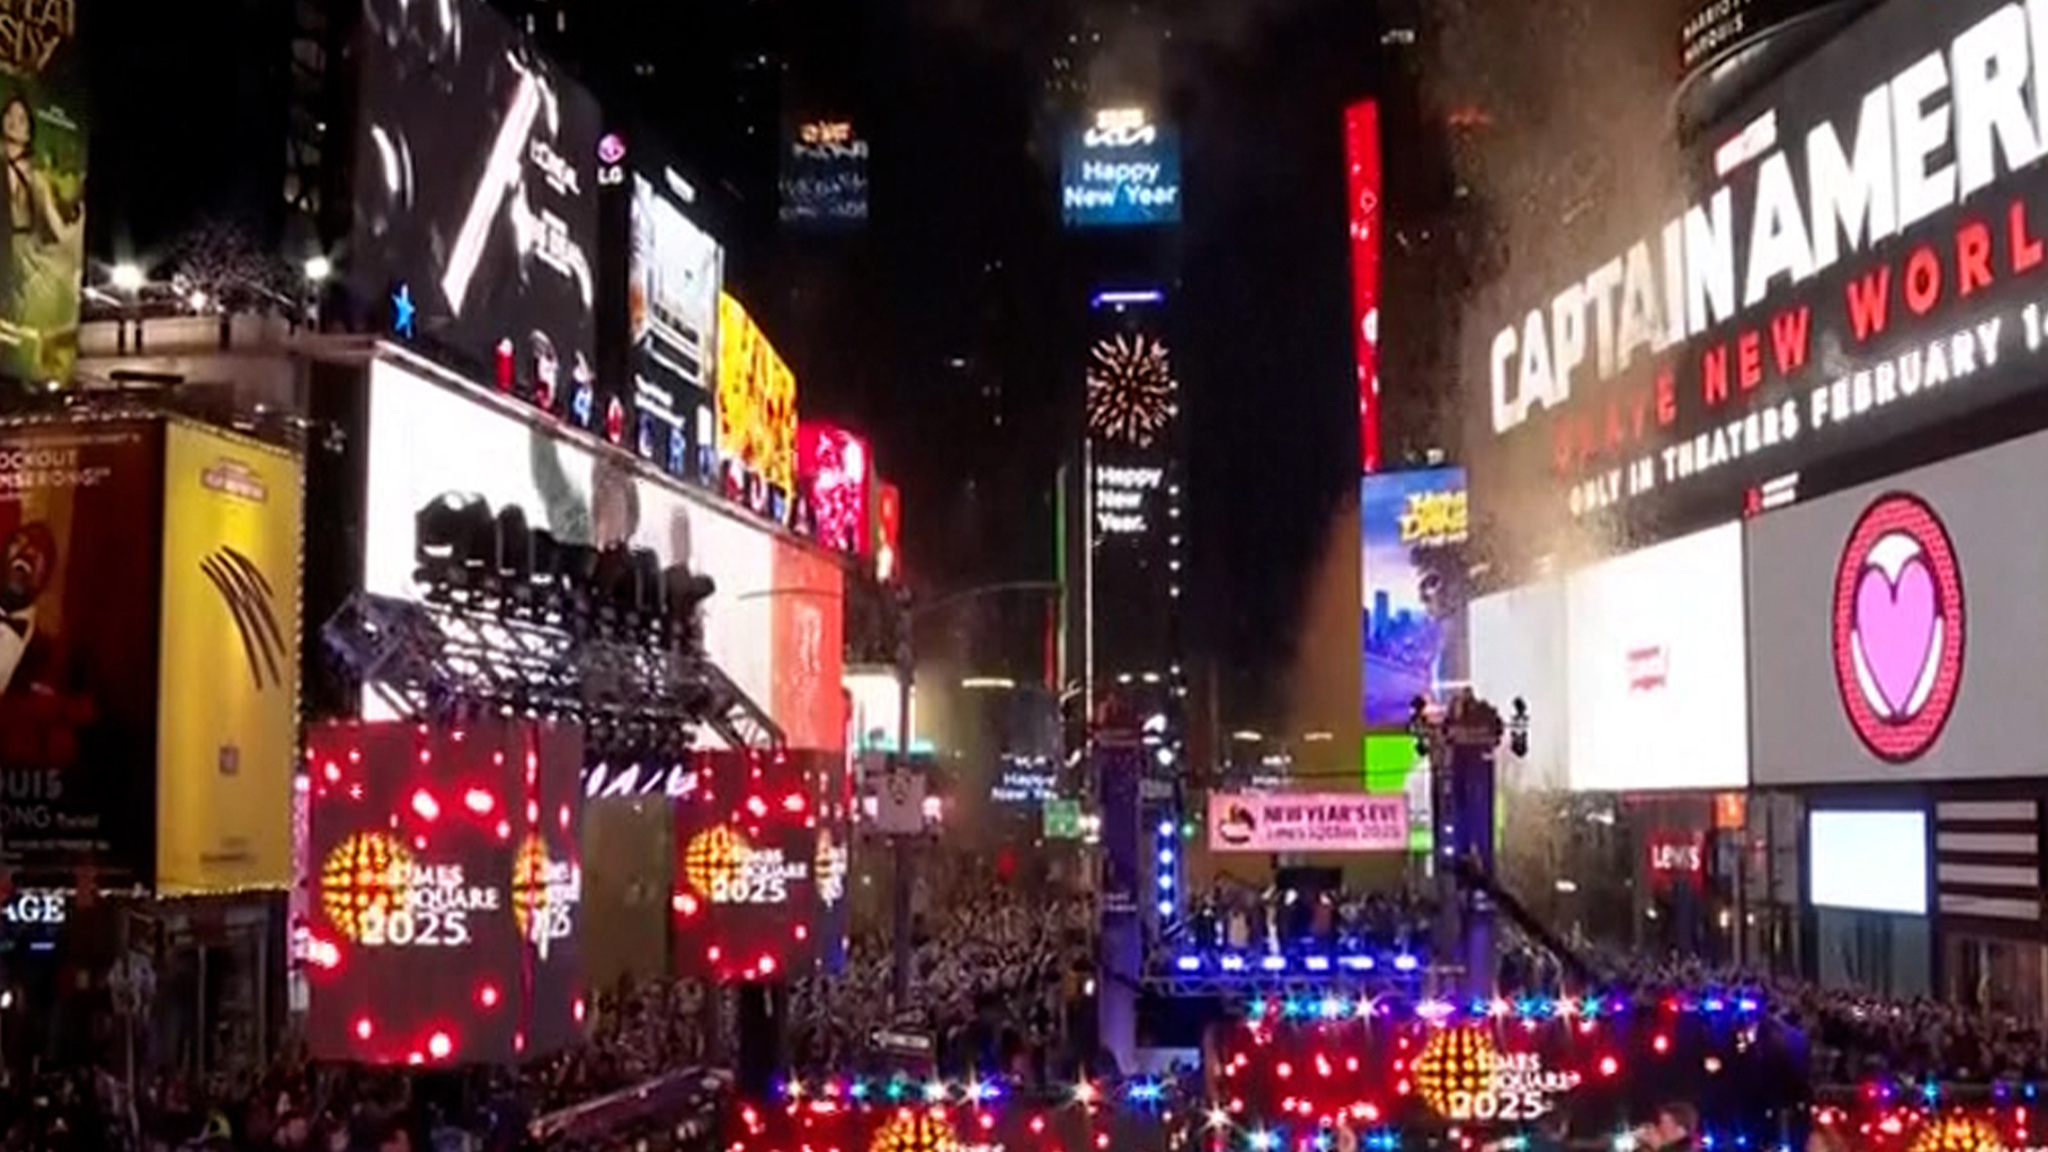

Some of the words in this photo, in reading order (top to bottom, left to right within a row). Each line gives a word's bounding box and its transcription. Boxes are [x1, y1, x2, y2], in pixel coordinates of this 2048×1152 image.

[1683, 0, 1749, 42] MARRIOT
[598, 165, 623, 185] LG
[1082, 160, 1160, 184] Happy
[1064, 185, 1117, 208] New
[1124, 184, 1178, 205] Year
[1491, 185, 1735, 435] CAPTAIN
[1703, 305, 1810, 406] NEW
[1846, 199, 2044, 341] WORL
[1569, 466, 1622, 517] ONLY
[1629, 455, 1655, 497] IN
[1661, 398, 1800, 482] THEATERS
[1810, 316, 2003, 430] FEBRUARY
[2022, 302, 2048, 352] 1
[1097, 465, 1163, 488] Happy
[1097, 488, 1142, 509] New
[1097, 511, 1147, 533] Year.
[0, 768, 63, 799] UIS
[1264, 805, 1303, 823] NEW
[1368, 804, 1398, 822] EVE
[403, 885, 499, 911] SQUARE
[711, 877, 788, 904] 2025
[361, 910, 470, 945] 2025
[1451, 1090, 1545, 1120] 2025
